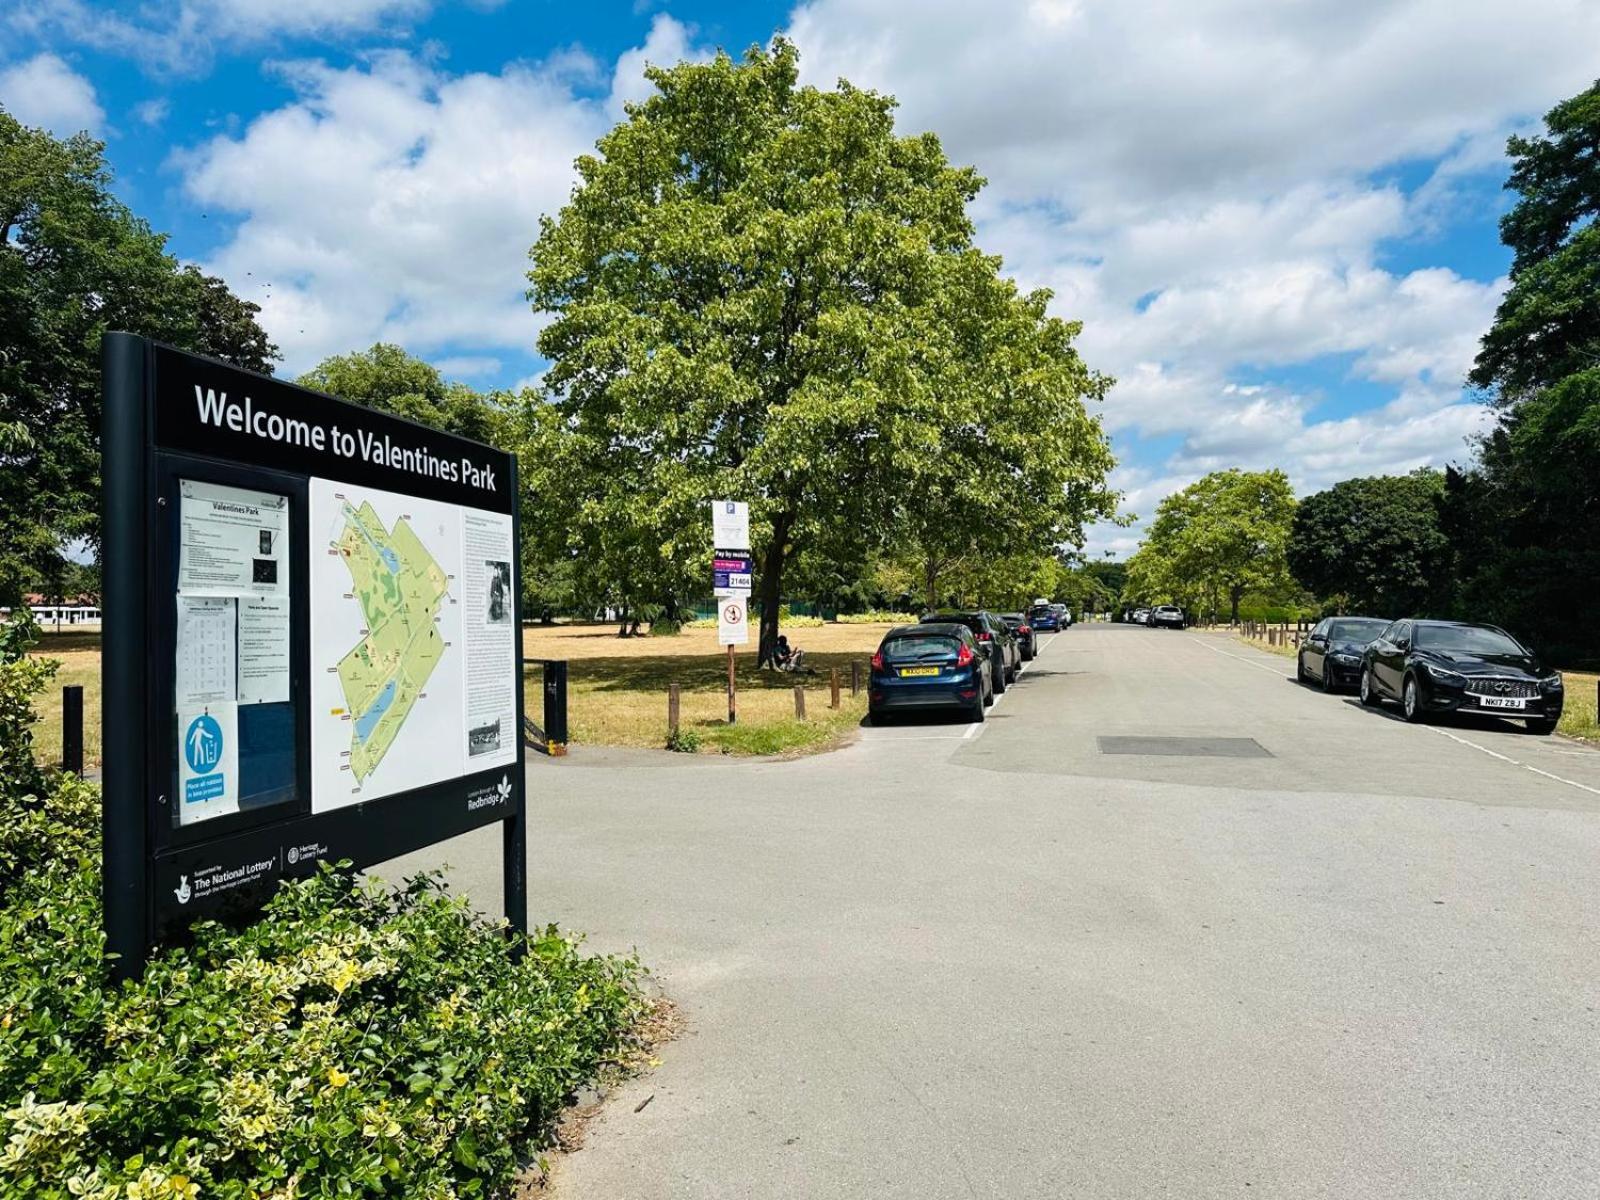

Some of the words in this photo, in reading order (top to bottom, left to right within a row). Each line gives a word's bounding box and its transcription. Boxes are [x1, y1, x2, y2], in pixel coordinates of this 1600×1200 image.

[194, 384, 325, 451] Welcome
[331, 425, 356, 458] to
[357, 428, 459, 483] Valentines
[462, 457, 497, 492] Park
[212, 501, 245, 514] Valentines
[245, 506, 259, 517] Park
[715, 550, 725, 558] Pay
[725, 550, 732, 559] by
[1485, 698, 1503, 706] NK17
[1504, 699, 1521, 707] ZBJ
[467, 792, 500, 811] Redbridge
[299, 842, 319, 853] Heritage
[299, 851, 316, 861] Lottery
[316, 846, 328, 856] Fund
[194, 878, 211, 890] The
[212, 865, 245, 885] National
